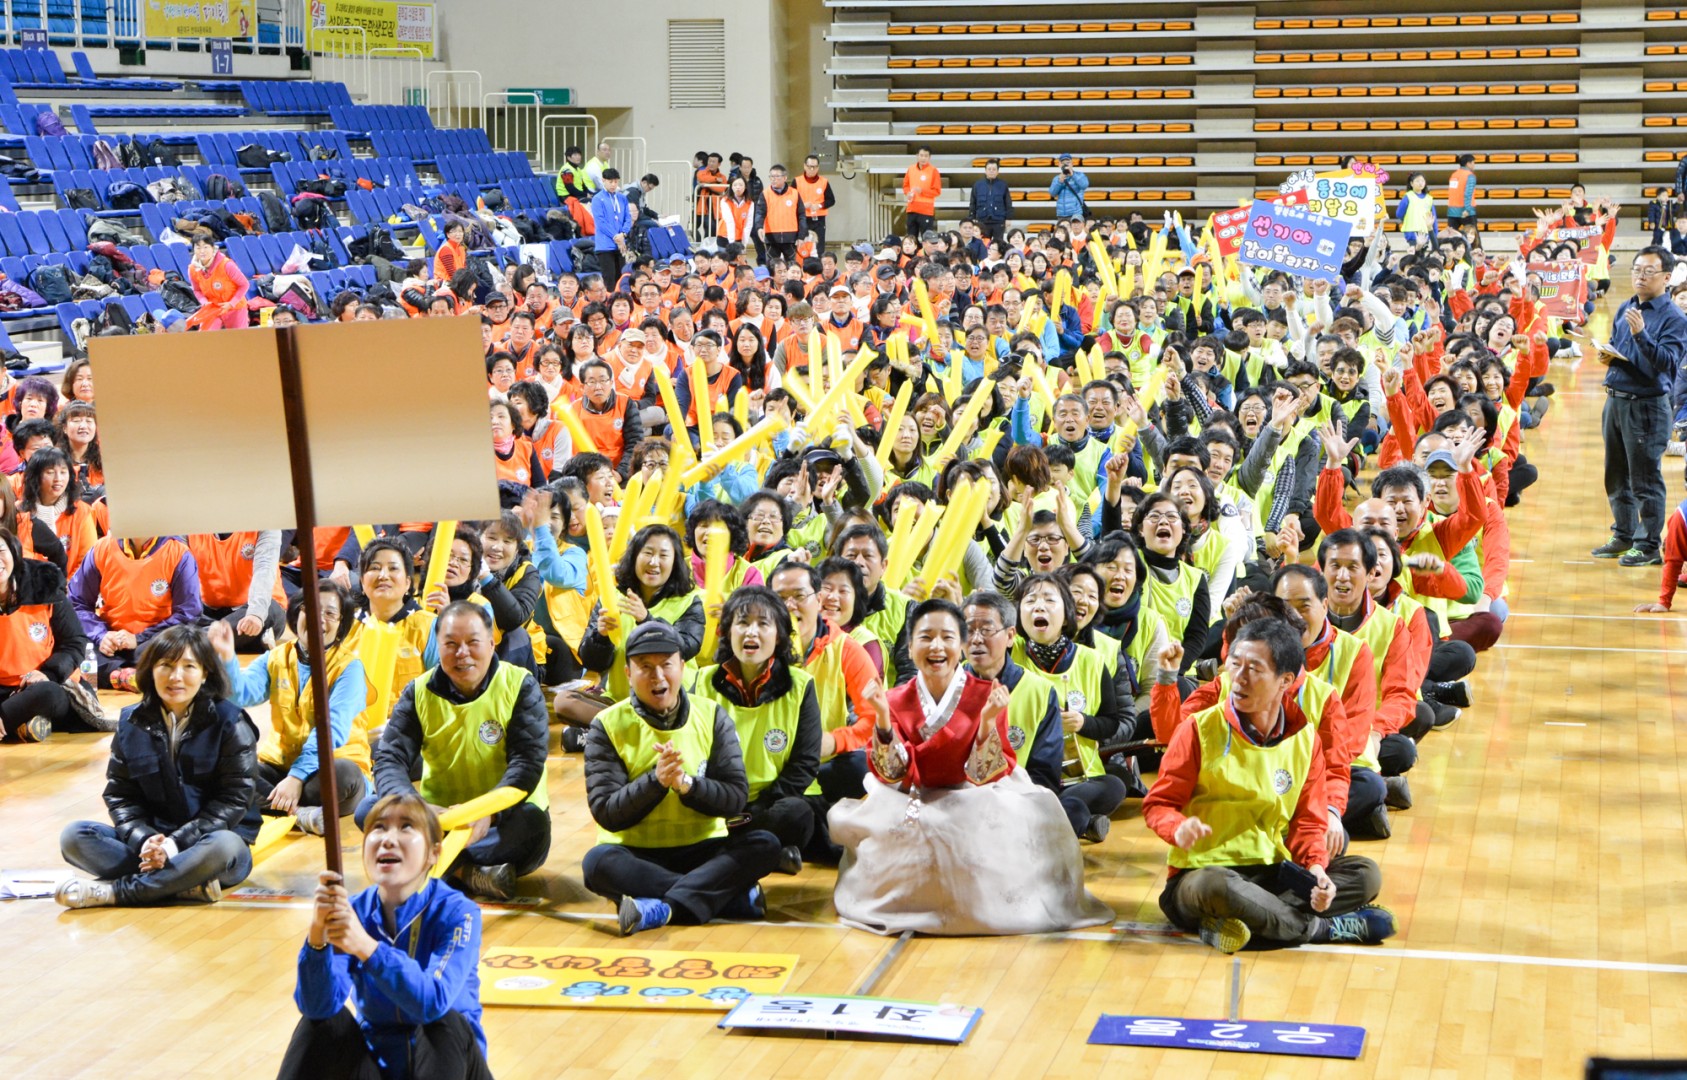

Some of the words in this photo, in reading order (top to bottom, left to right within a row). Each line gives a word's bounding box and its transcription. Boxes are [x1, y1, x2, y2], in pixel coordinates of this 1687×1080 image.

[215, 54, 230, 73] 1-7
[1252, 215, 1313, 245] 선기야
[1125, 1019, 1335, 1044] 우2동
